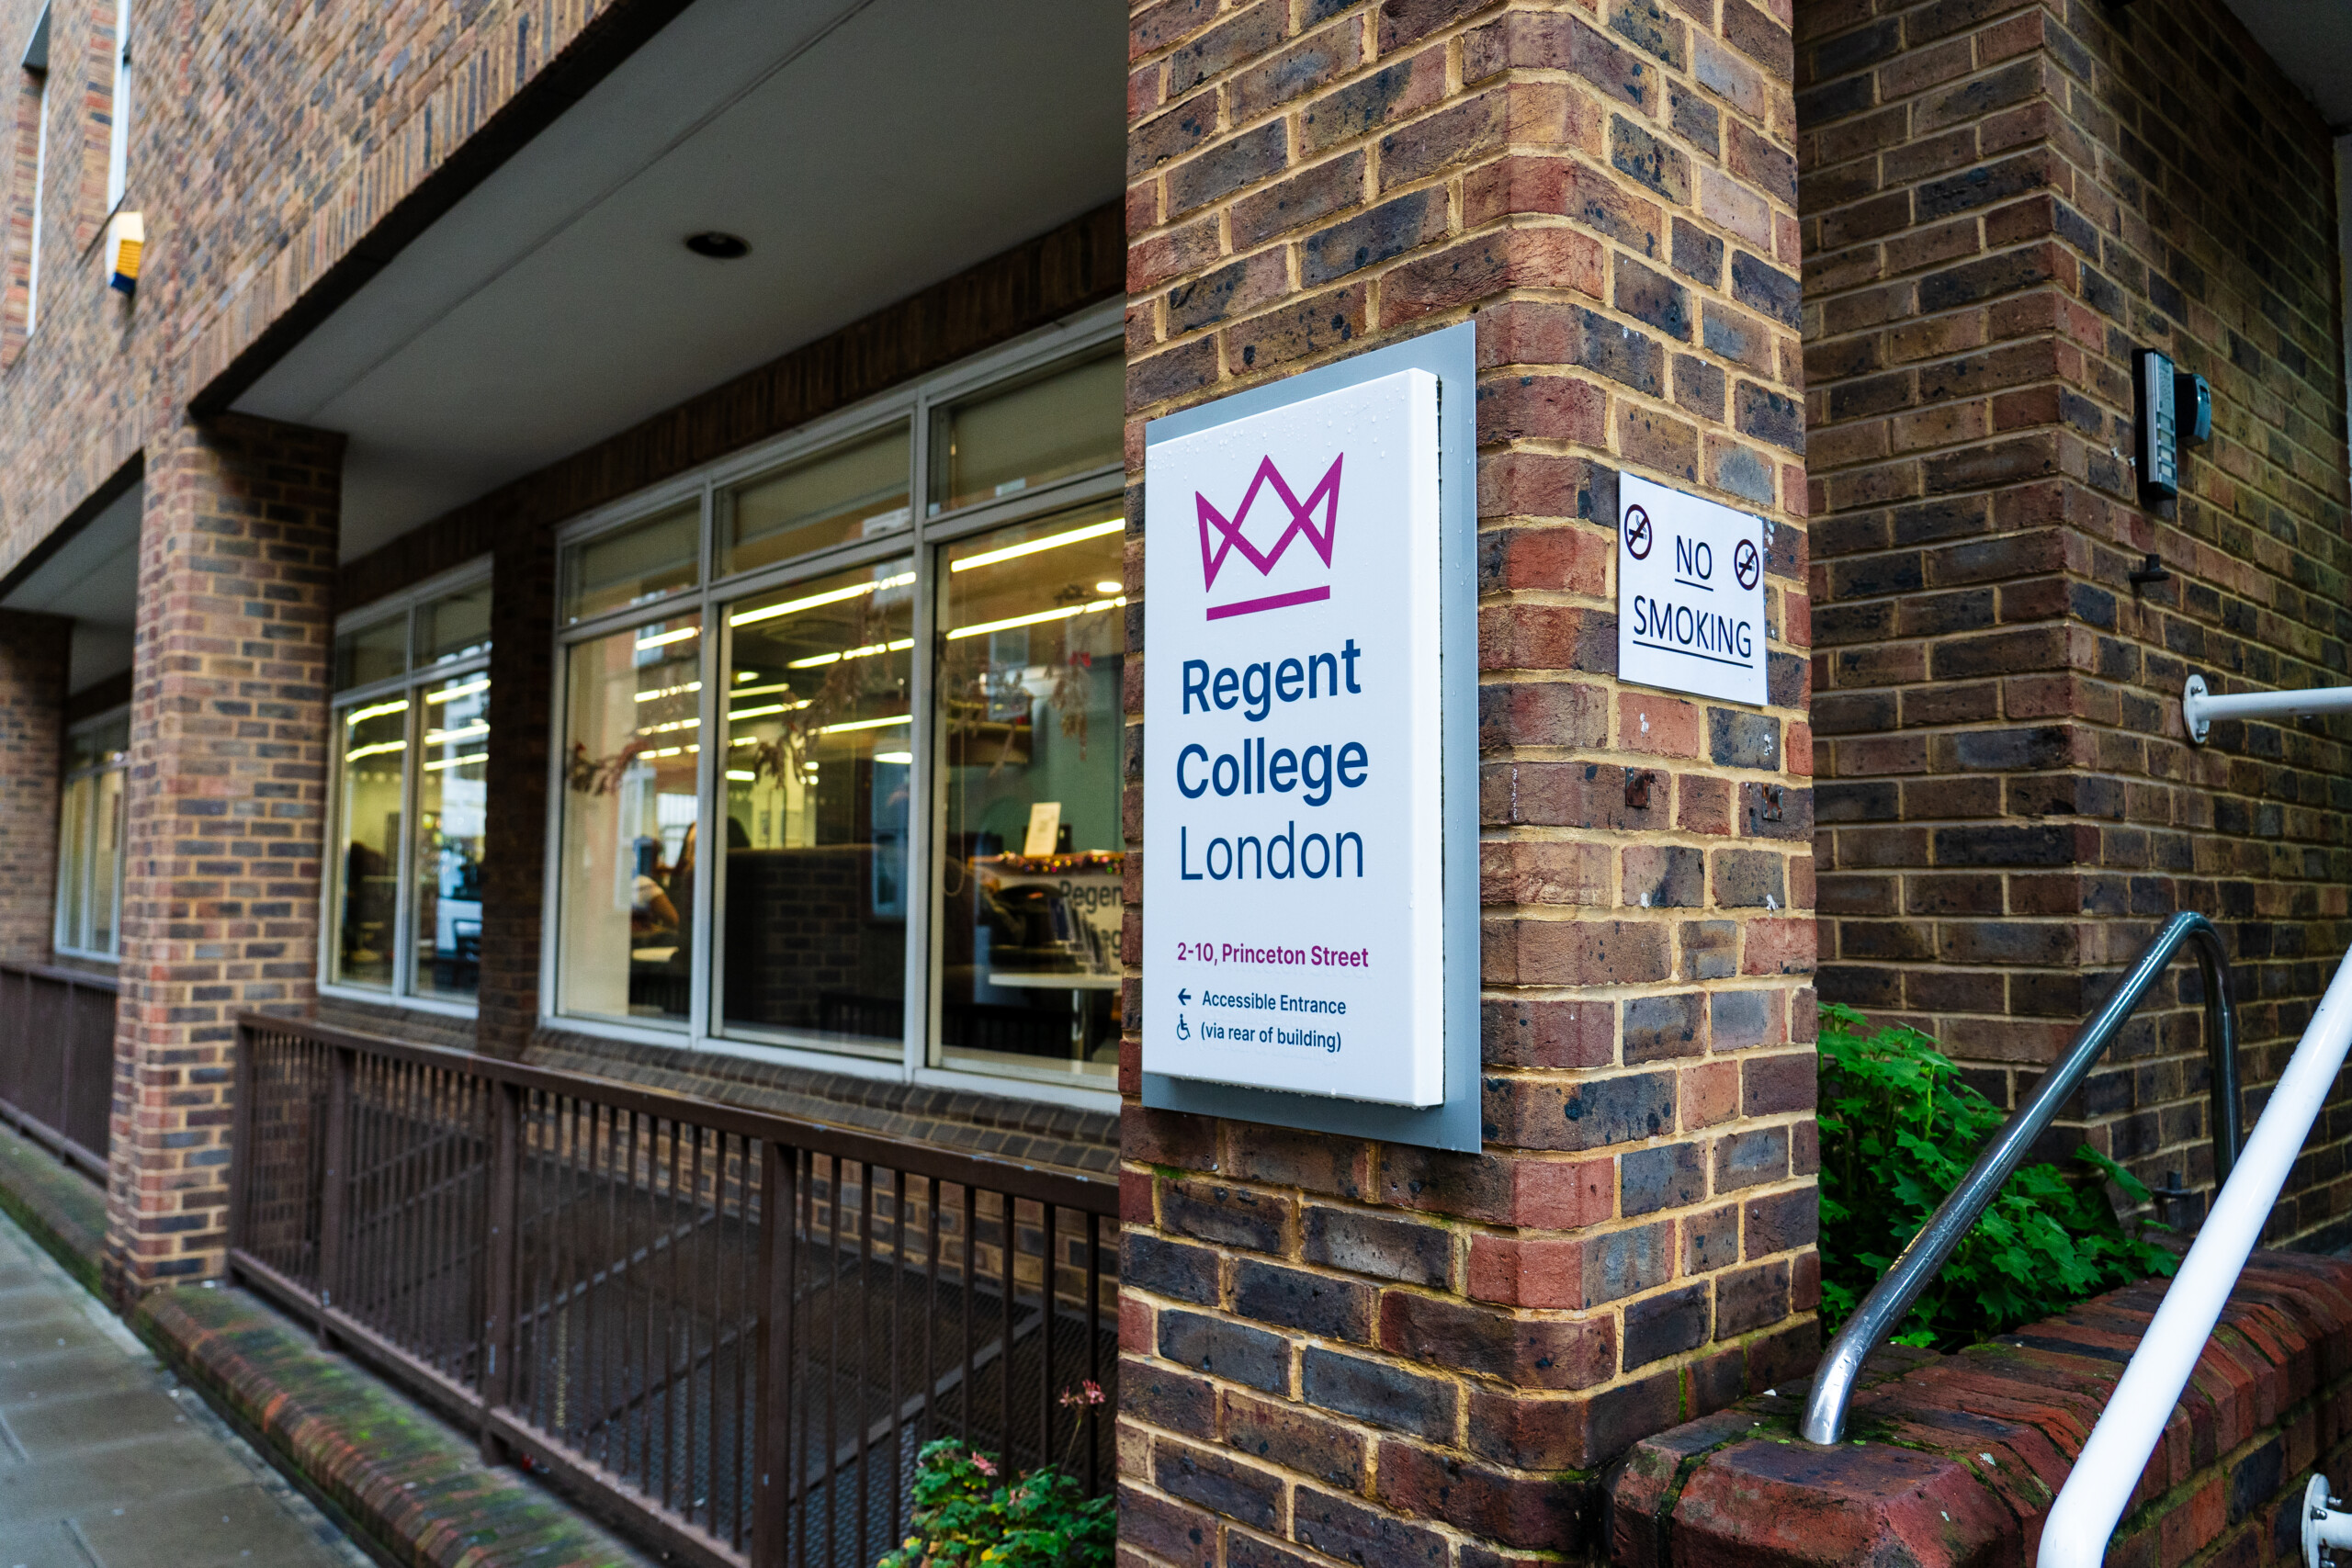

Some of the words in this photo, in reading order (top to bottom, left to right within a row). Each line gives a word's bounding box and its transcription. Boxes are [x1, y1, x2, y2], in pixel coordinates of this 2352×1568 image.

[1677, 535, 1713, 581] NO
[1634, 594, 1752, 659] SMOKING
[1182, 638, 1363, 723] Regent
[1176, 736, 1369, 807] College
[1181, 819, 1363, 881] London
[1177, 942, 1218, 966] 2-10,
[1222, 942, 1306, 965] Princeton
[1310, 944, 1369, 967] Street
[1202, 989, 1277, 1011] Accessible
[1280, 994, 1347, 1015] Entrance
[1200, 1021, 1225, 1041] (via
[1227, 1027, 1256, 1043] rear
[1259, 1026, 1274, 1043] of
[1277, 1027, 1342, 1054] building)
